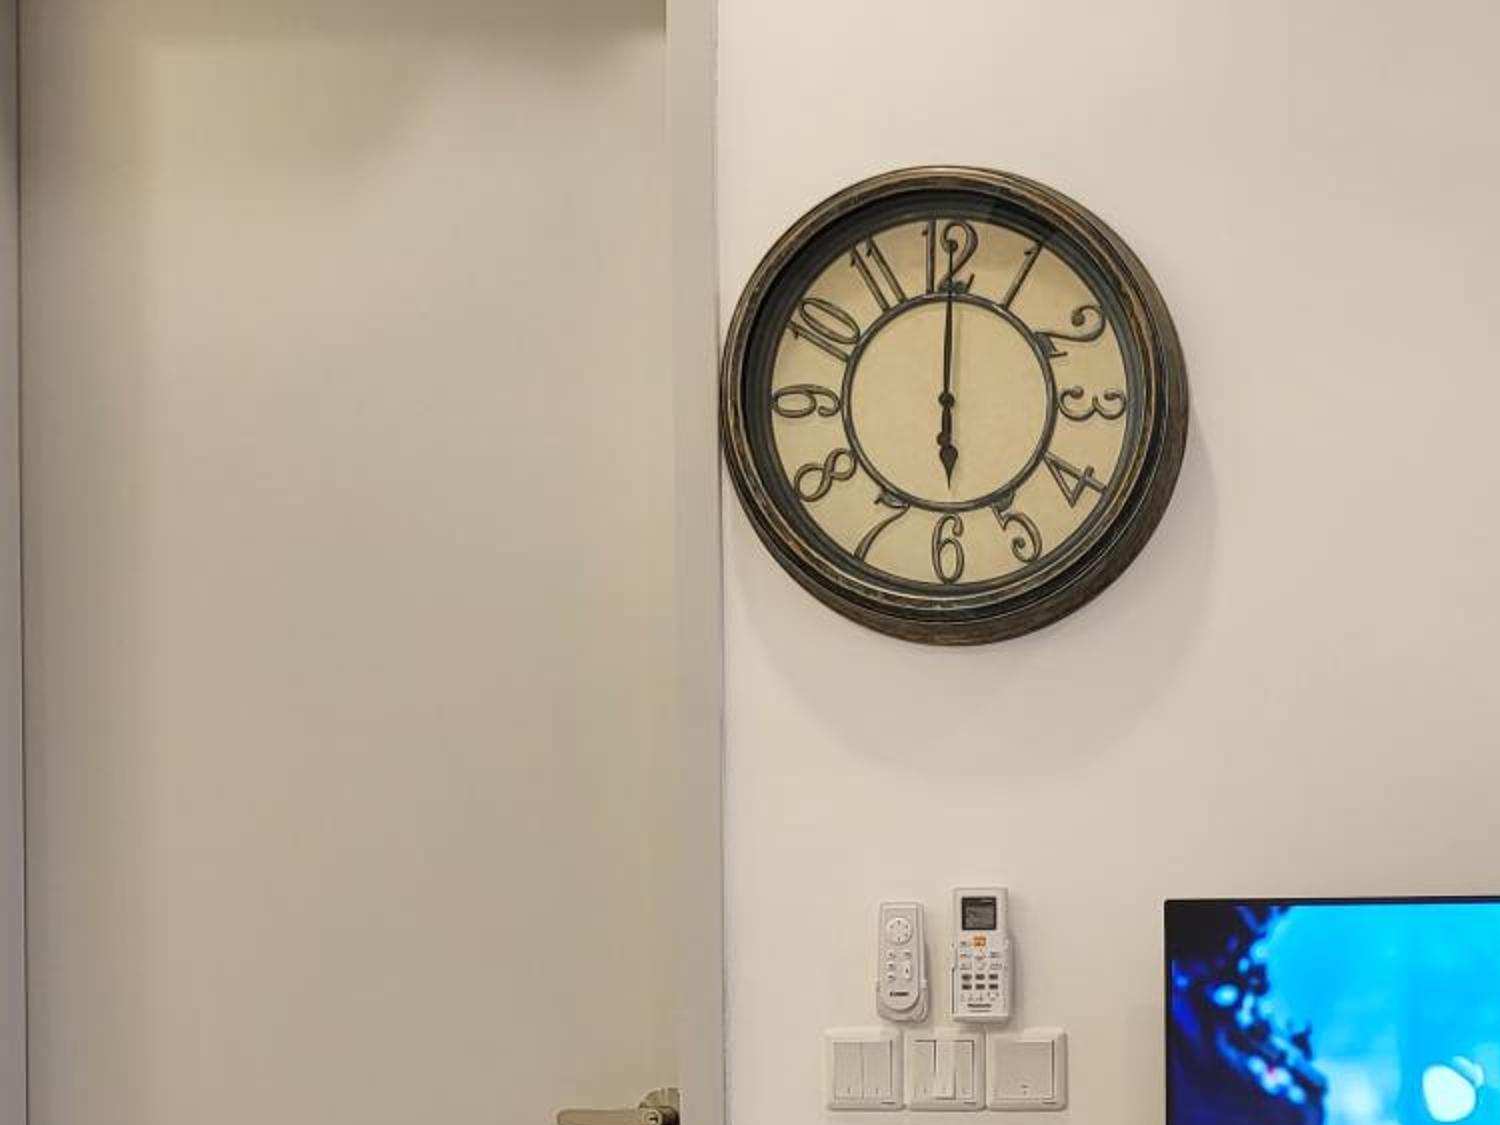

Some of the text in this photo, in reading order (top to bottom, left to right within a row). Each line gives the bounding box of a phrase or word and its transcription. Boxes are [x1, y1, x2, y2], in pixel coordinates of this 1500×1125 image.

[849, 234, 906, 312] 11
[922, 218, 979, 295] 12
[1003, 240, 1045, 311] 1
[786, 296, 862, 364] 10
[1032, 303, 1107, 358] 2
[769, 383, 841, 418] 9
[1058, 386, 1127, 421] 3
[794, 448, 857, 502] 8
[1044, 450, 1109, 508] 4
[854, 484, 911, 561] 7
[931, 512, 964, 584] 6
[992, 490, 1043, 563] 5
